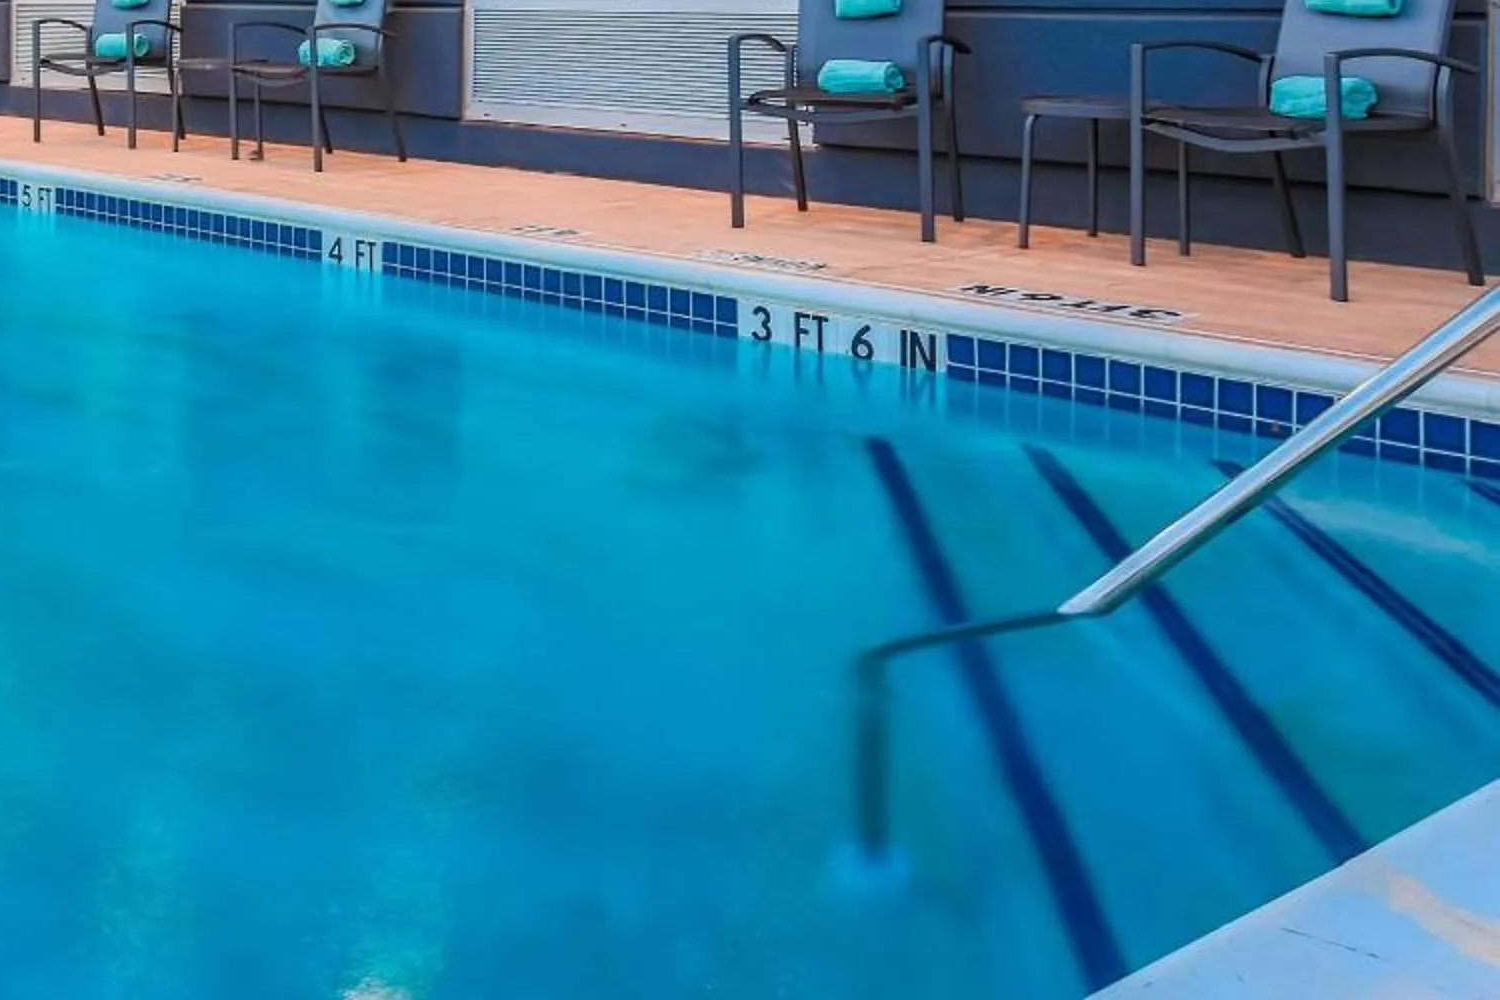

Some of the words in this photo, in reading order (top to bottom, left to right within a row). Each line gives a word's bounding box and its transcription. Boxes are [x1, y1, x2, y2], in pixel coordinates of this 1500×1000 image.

[22, 185, 31, 207] 5
[38, 187, 52, 211] FT
[328, 236, 343, 264] 4
[355, 239, 376, 270] FT
[752, 305, 772, 341] 3
[794, 311, 829, 352] FT
[851, 324, 874, 361] 6
[900, 329, 937, 373] IN
